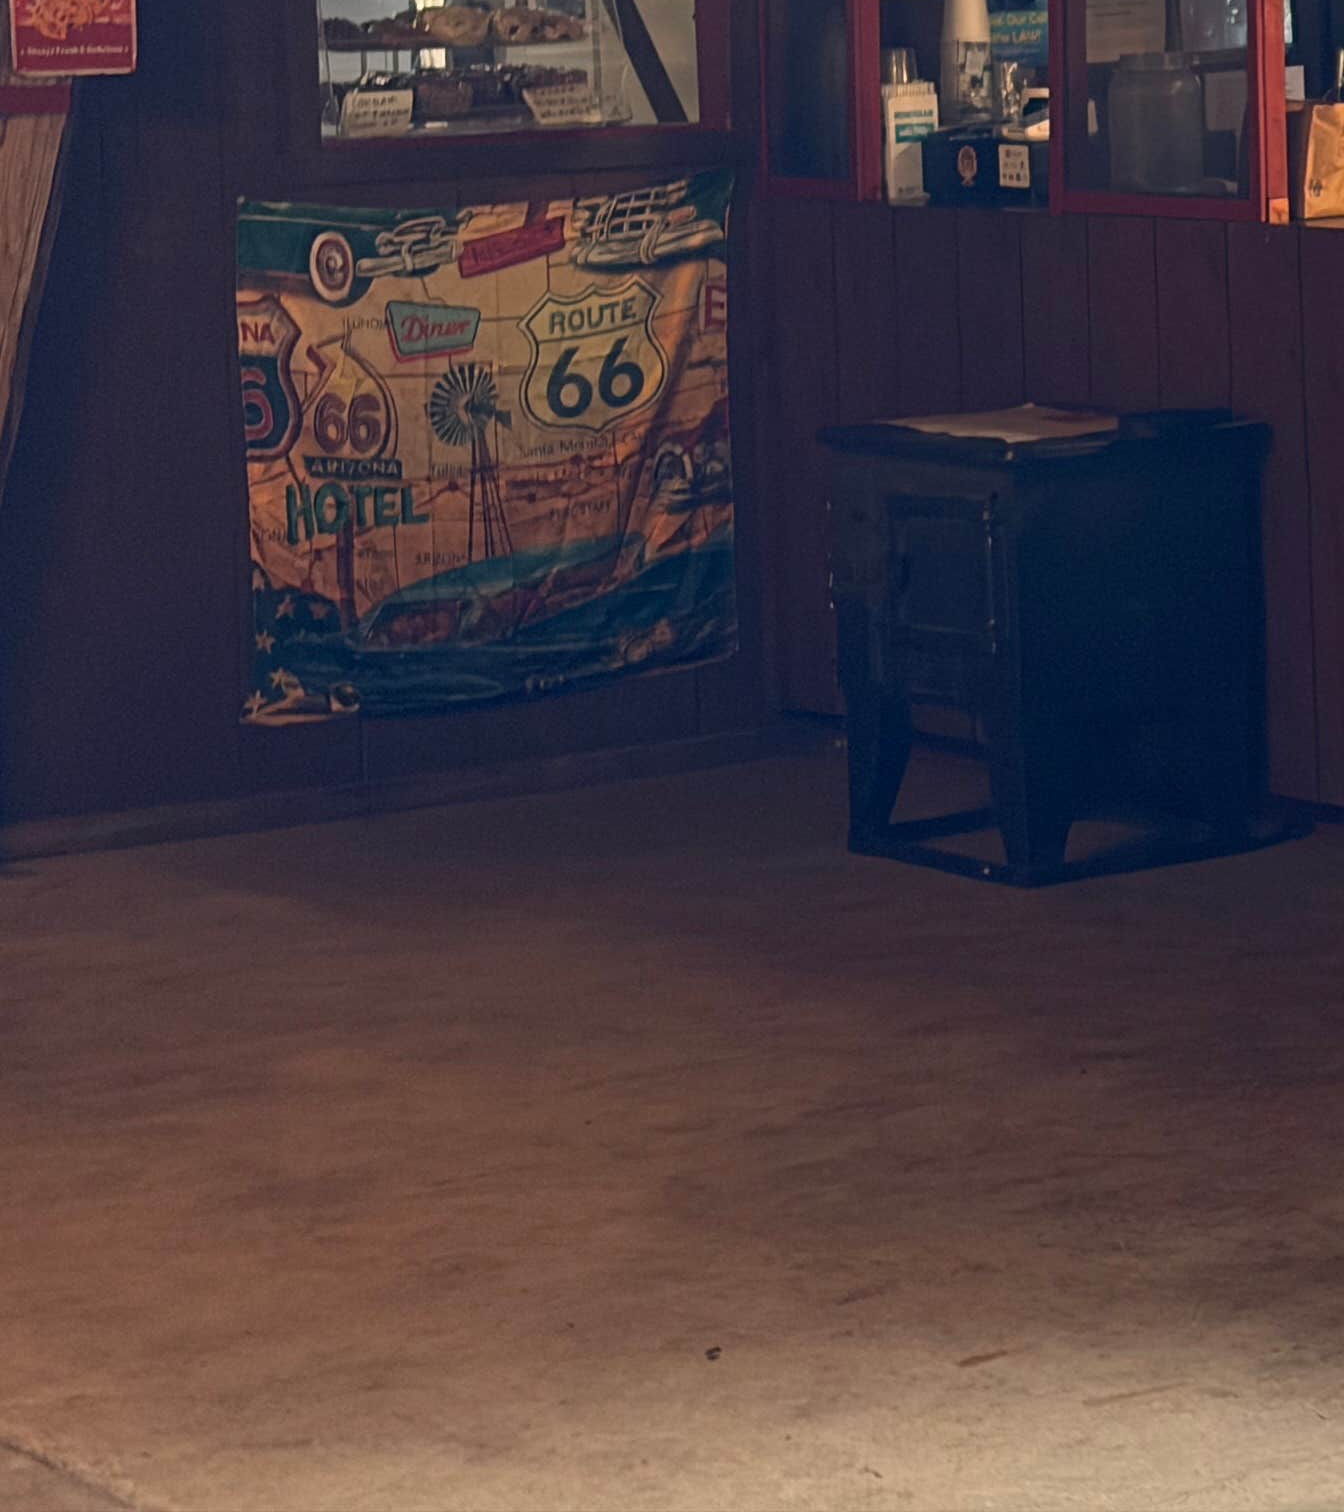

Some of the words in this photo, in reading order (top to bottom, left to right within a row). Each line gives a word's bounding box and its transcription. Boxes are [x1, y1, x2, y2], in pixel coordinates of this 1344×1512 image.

[401, 312, 470, 342] Diner
[547, 296, 638, 333] ROUTE
[546, 335, 646, 420] 66
[313, 390, 386, 456] 66
[286, 481, 430, 546] HOTEL
